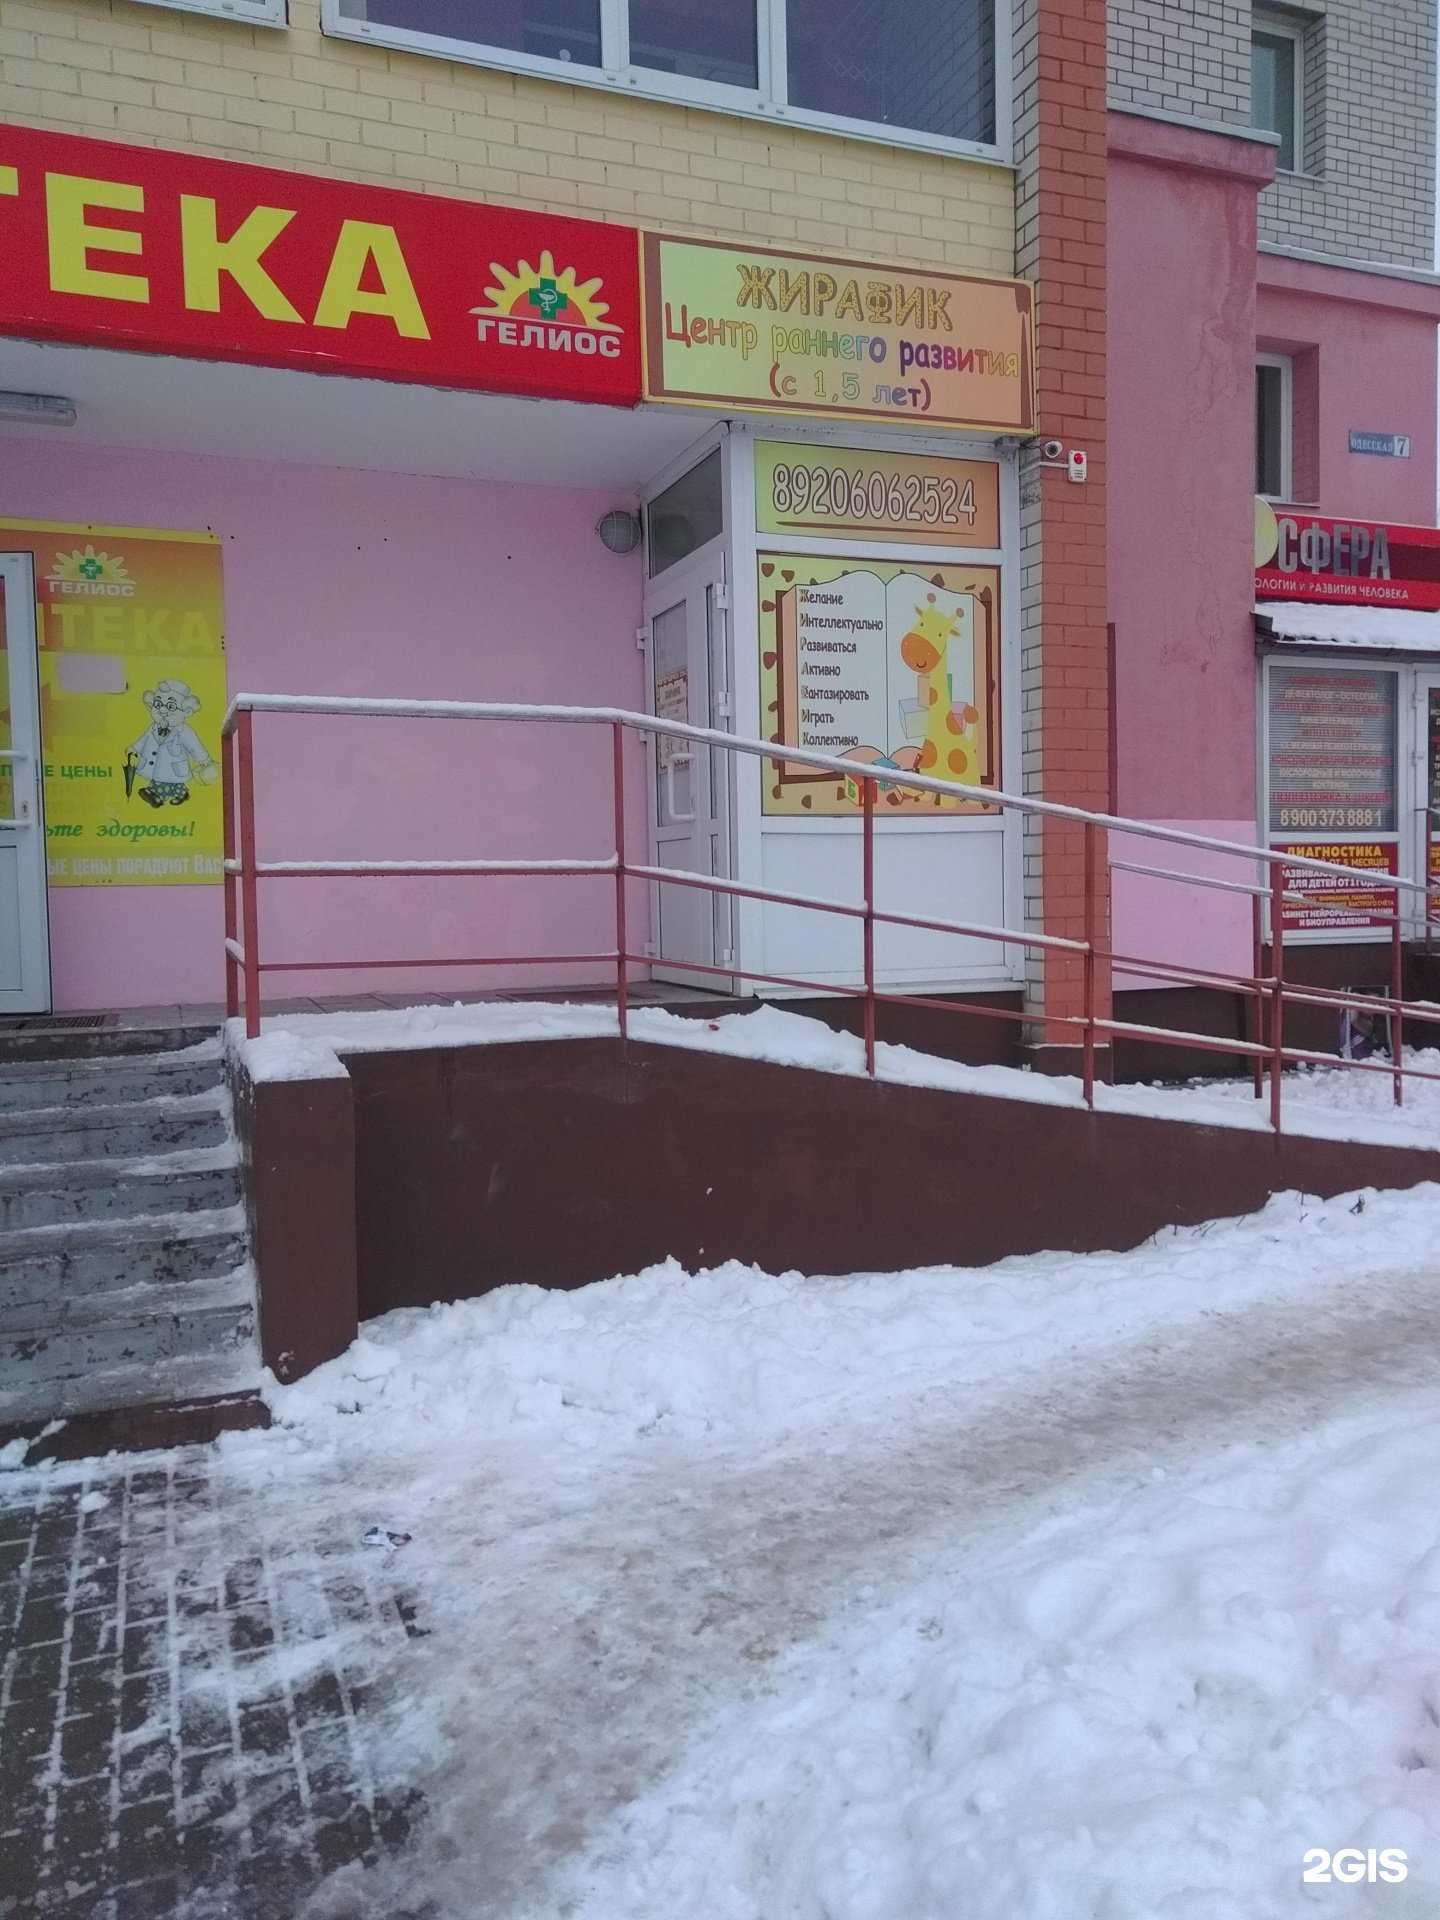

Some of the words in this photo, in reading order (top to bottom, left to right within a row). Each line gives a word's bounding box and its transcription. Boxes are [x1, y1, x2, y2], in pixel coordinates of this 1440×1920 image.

[0, 165, 431, 340] ЕКА
[736, 263, 953, 332] ЖИРАФИК
[478, 318, 621, 358] ГЕЛИОС
[665, 301, 758, 360] Центр
[771, 324, 886, 364] раннего
[899, 338, 1019, 377] развития
[769, 361, 797, 397] (с
[814, 369, 860, 402] 1,5
[871, 378, 931, 411] лет)
[1398, 437, 1406, 456] 7
[772, 462, 977, 526] 89206062524
[1278, 517, 1392, 581] СФЕРА
[49, 581, 135, 597] ГЕЛИОС
[800, 589, 844, 605] Желание
[1255, 577, 1297, 591] ОЛОГИИ
[1309, 582, 1356, 595] РАЗВИТИЯ
[1358, 586, 1409, 599] ЧЕЛОВЕКА
[800, 613, 883, 634] Интеллектуально
[800, 637, 857, 653] Развиваться
[801, 662, 841, 677] Активно
[801, 685, 870, 704] Фантазировать
[801, 709, 835, 727] Играть
[803, 732, 859, 746] Коллективно
[61, 765, 113, 780] ЦЕНЫ
[46, 823, 83, 838] ьте
[96, 819, 196, 843] здоровы!
[1287, 845, 1382, 858] ДИАГНОСТИКА
[1288, 879, 1308, 890] ДЛЯ
